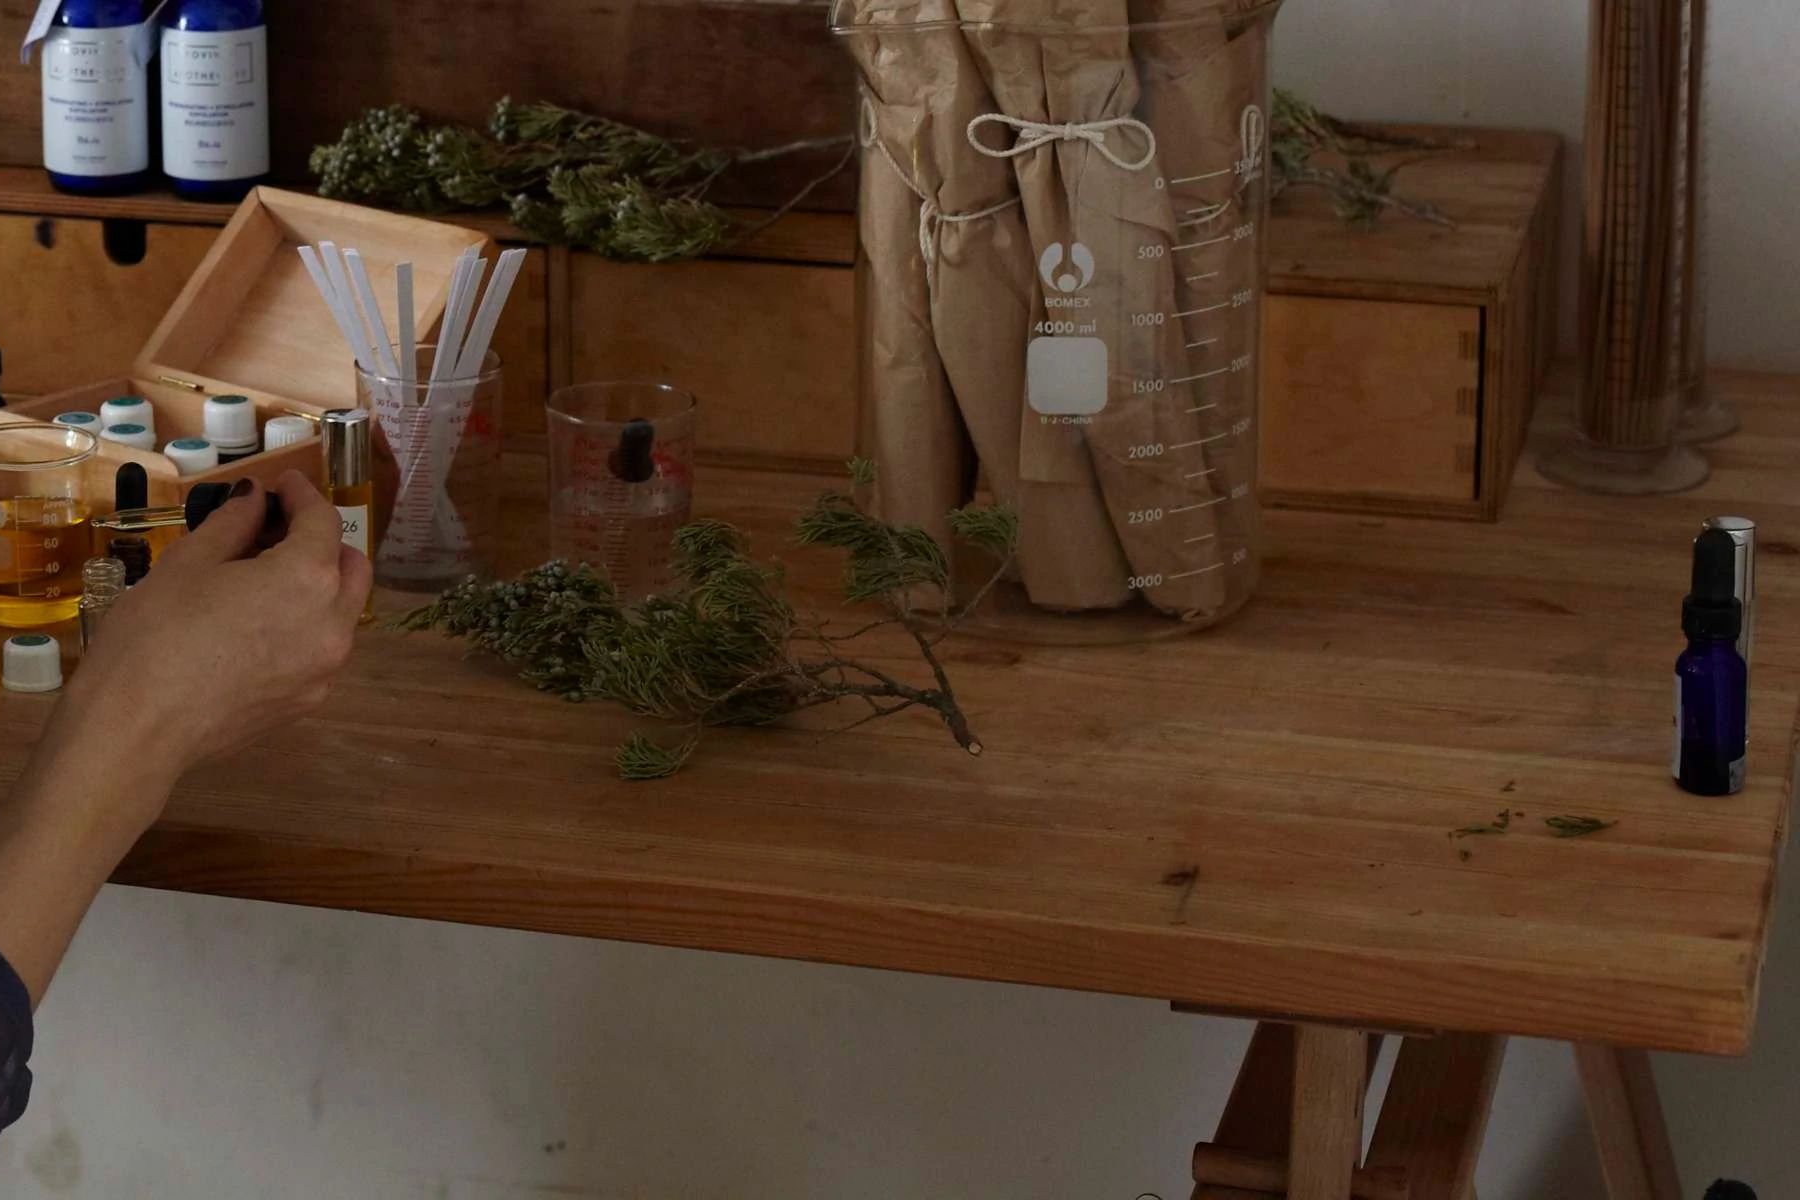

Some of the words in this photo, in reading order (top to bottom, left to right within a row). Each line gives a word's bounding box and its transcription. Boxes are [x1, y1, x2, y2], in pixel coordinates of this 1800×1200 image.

[1154, 176, 1165, 189] 0
[1233, 221, 1254, 241] 3000
[1137, 244, 1165, 259] 500
[1044, 297, 1091, 308] BOMEX
[1231, 288, 1253, 309] 2500
[1034, 320, 1075, 334] 4000
[1079, 318, 1098, 334] ml
[1131, 312, 1165, 327] 1000
[1132, 378, 1165, 394] 1500
[1128, 442, 1165, 460] 2000
[42, 512, 58, 525] 80
[1127, 507, 1164, 525] 2500
[341, 520, 358, 533] 26
[43, 537, 59, 549] 60
[45, 561, 61, 574] 40
[1127, 573, 1164, 590] 3000
[46, 585, 61, 598] 20
